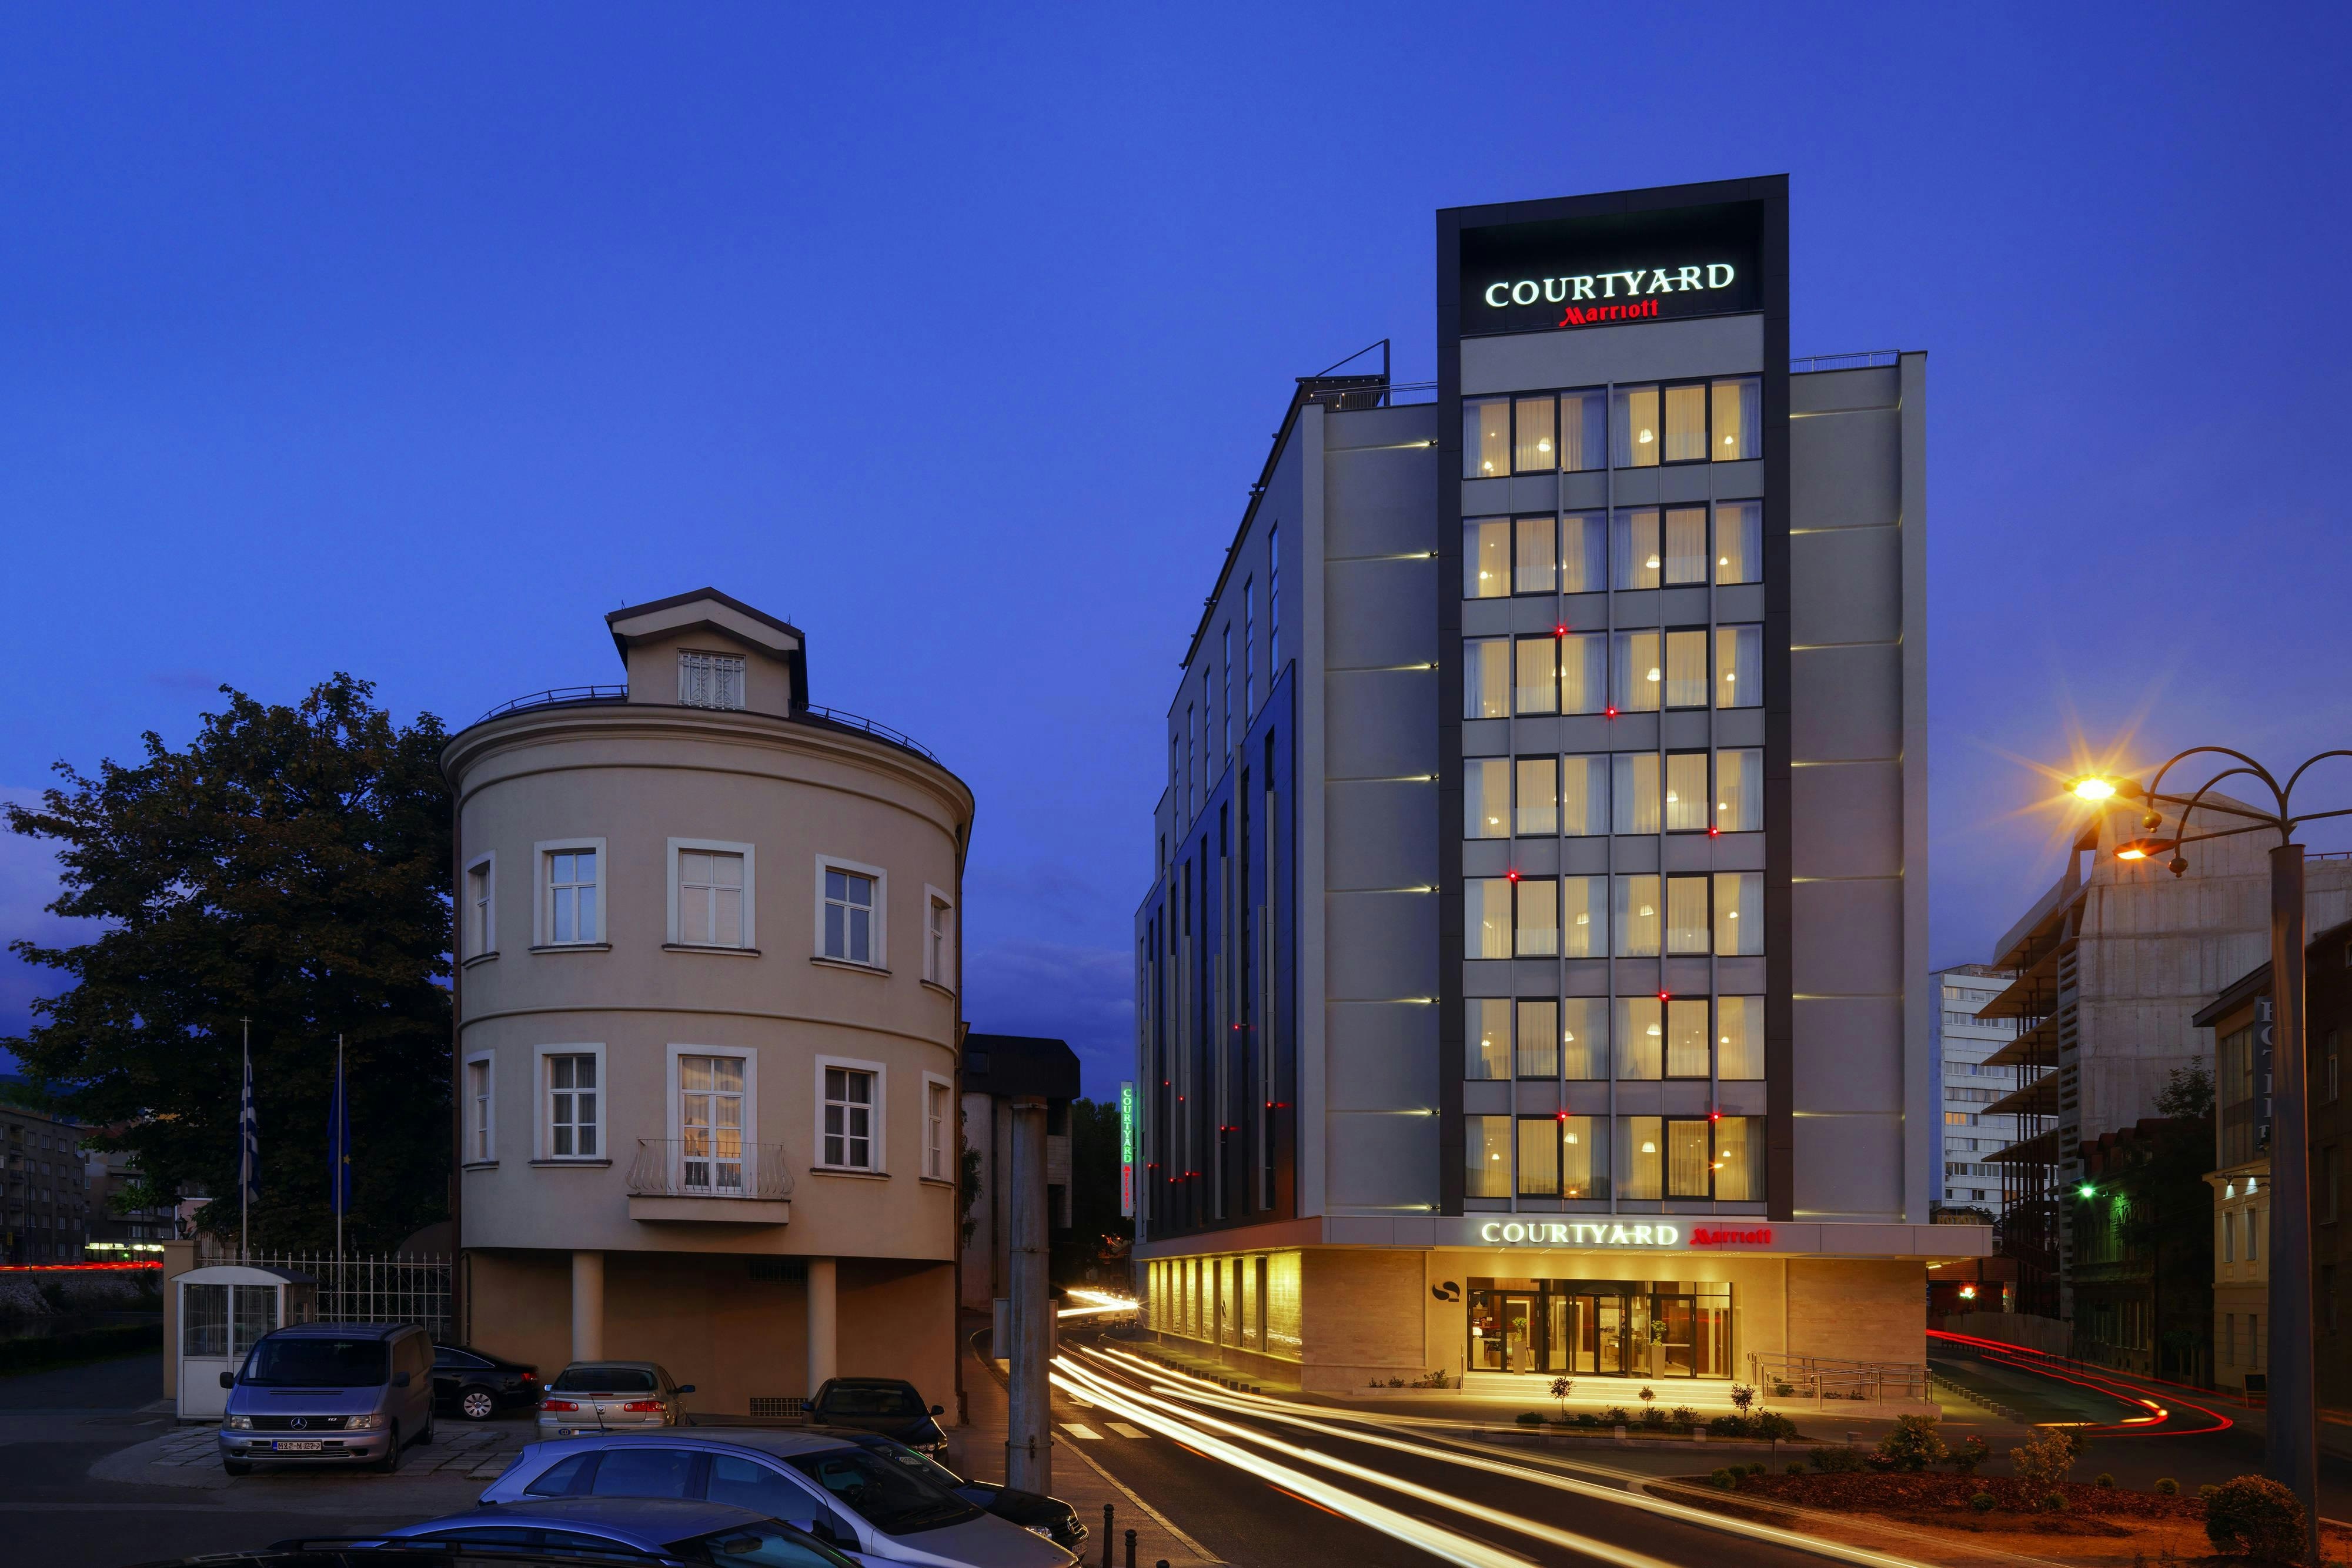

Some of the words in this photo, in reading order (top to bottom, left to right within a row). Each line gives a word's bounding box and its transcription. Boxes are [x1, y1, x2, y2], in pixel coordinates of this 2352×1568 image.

[1485, 263, 1735, 307] COURTYARD
[1558, 299, 1658, 327] Marriott
[1122, 1088, 1132, 1163] COURTYARD
[1481, 1222, 1679, 1245] COURTYARD
[1689, 1227, 1772, 1246] Marriott
